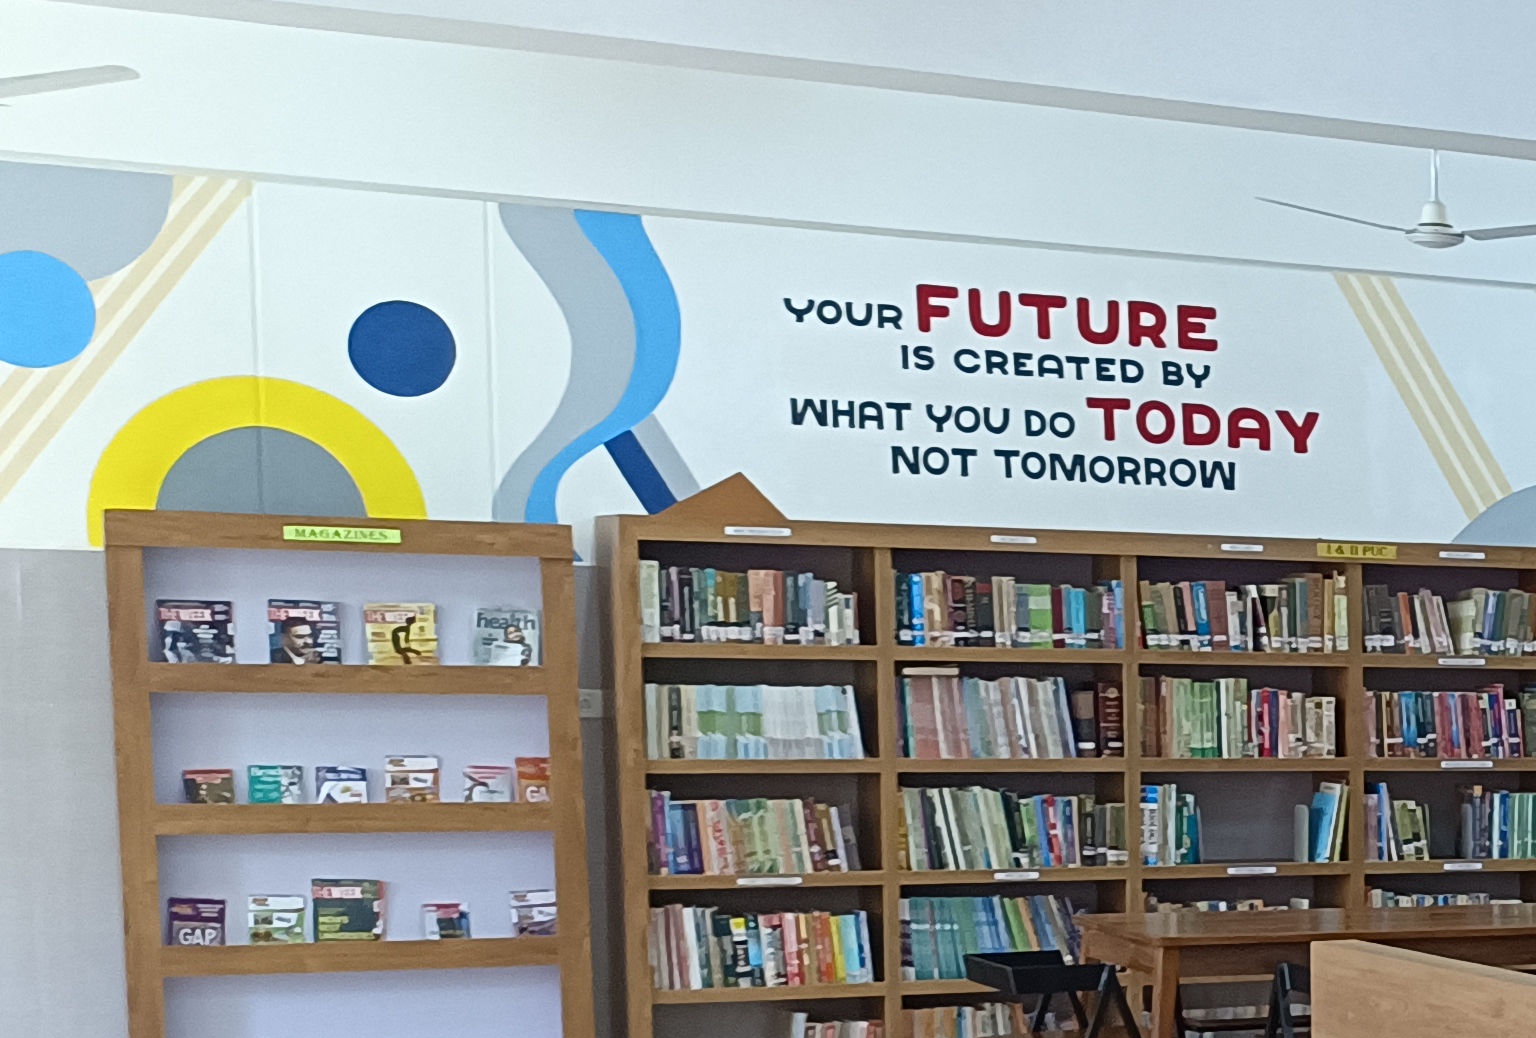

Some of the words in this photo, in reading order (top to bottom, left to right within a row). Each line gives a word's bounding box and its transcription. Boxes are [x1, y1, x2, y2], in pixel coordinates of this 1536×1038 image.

[783, 298, 903, 329] YOUR
[915, 284, 1218, 351] FUTURE
[900, 345, 935, 370] IS
[953, 348, 1143, 384] CREATED
[1161, 360, 1211, 388] BY
[789, 398, 912, 431] WHAT
[925, 404, 1010, 434] YOU
[1025, 409, 1076, 439] DO
[1086, 397, 1319, 454] TODAY
[891, 446, 978, 477] NOT
[994, 449, 1236, 490] TOMORROW
[294, 528, 388, 541] MAGAZINES
[178, 927, 219, 945] GAP
